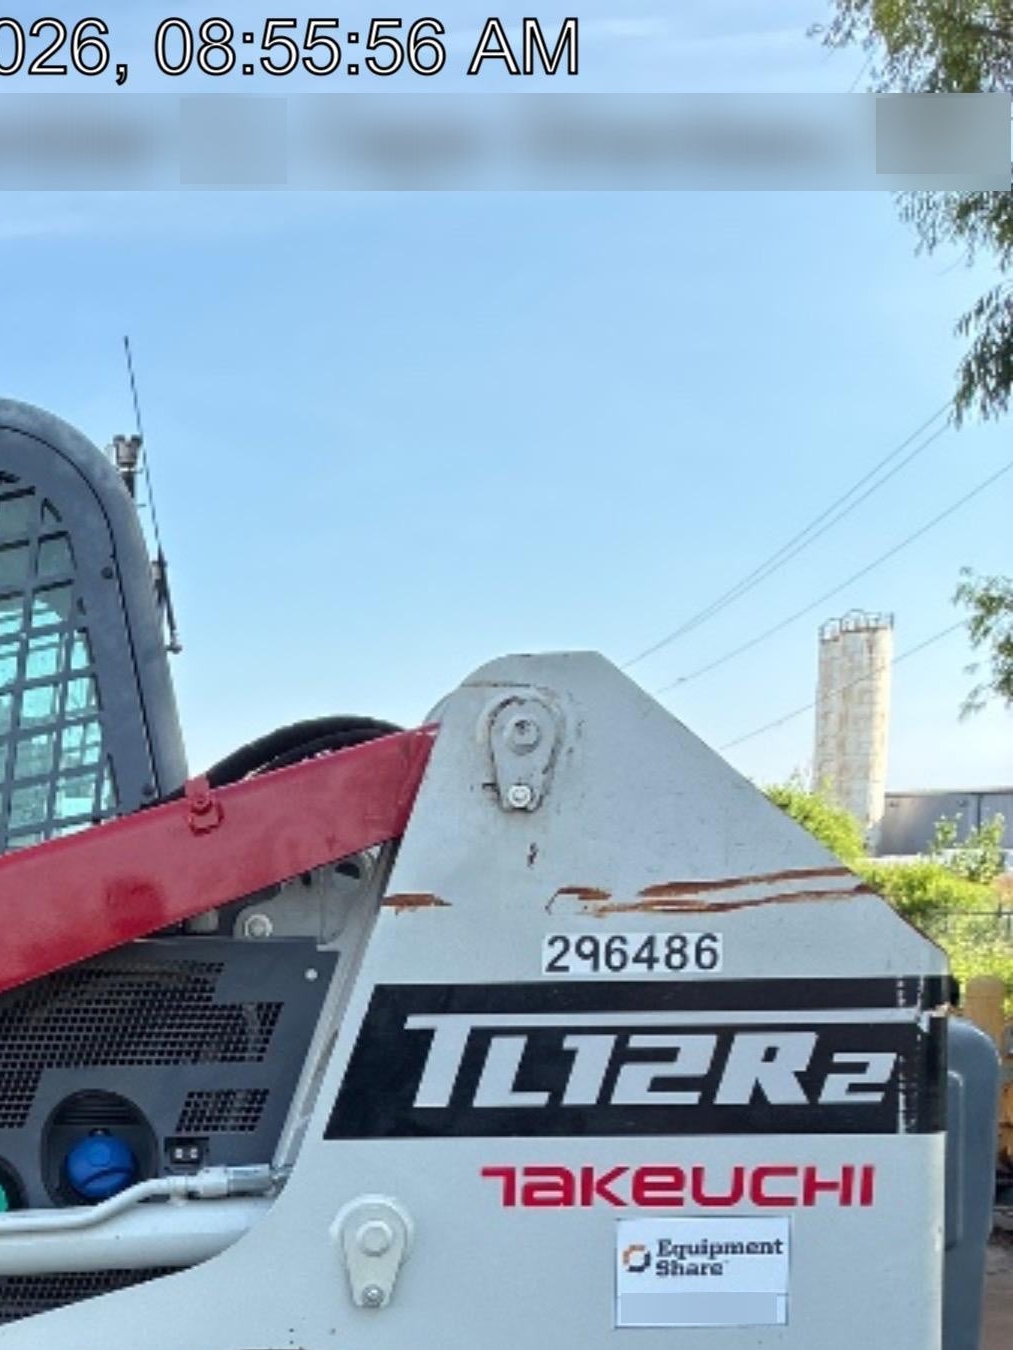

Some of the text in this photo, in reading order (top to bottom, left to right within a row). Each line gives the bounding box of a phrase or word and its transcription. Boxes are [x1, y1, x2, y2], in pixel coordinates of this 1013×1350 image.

[544, 933, 720, 973] 296486
[404, 1008, 916, 1109] TL12R2
[655, 1238, 784, 1260] Equipment
[655, 1259, 724, 1277] Share
